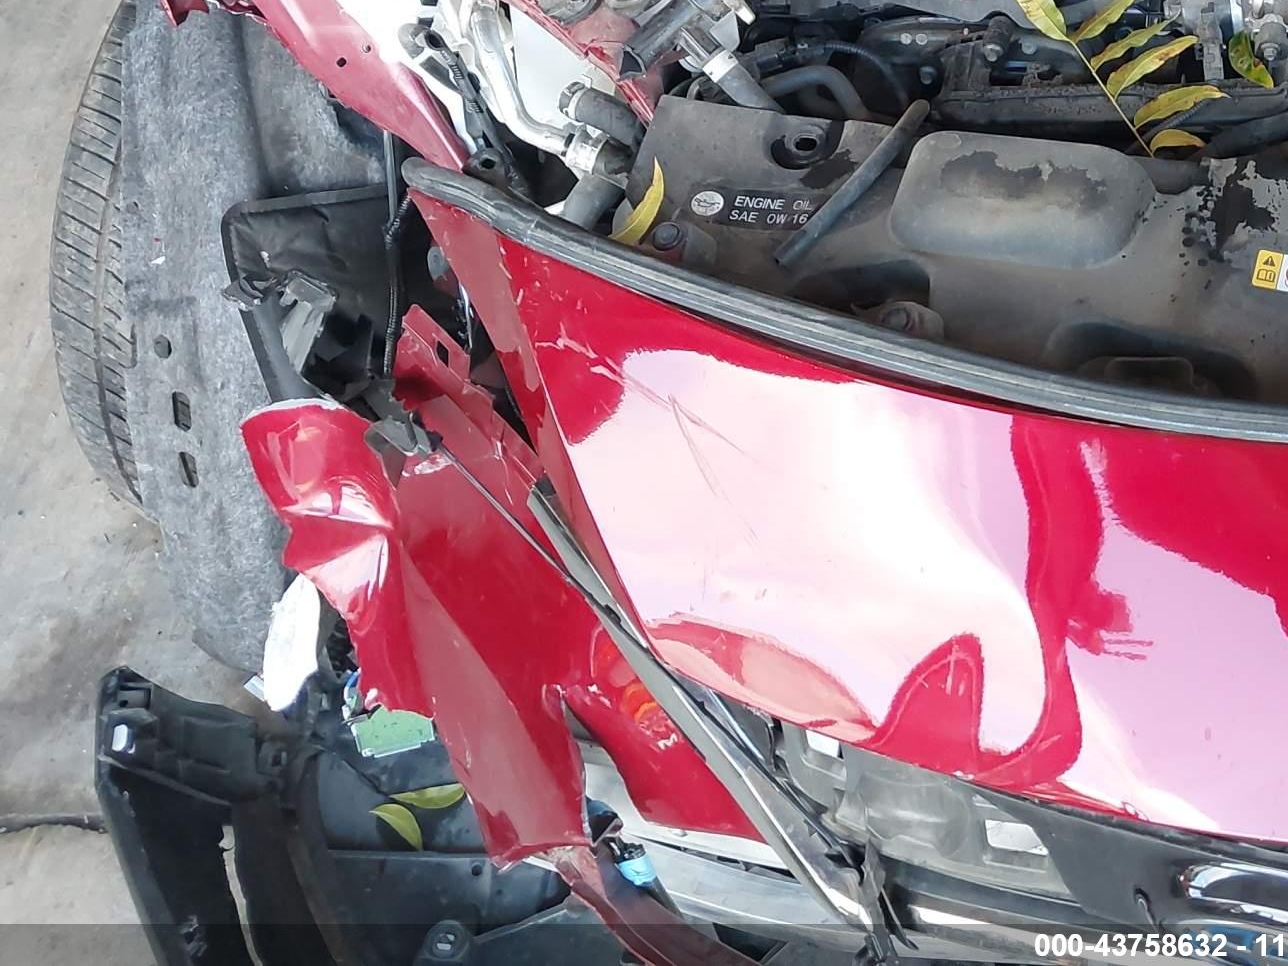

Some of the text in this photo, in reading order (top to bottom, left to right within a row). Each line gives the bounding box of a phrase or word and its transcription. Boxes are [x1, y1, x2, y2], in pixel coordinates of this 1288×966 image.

[734, 195, 814, 211] ENGINE OIL
[729, 209, 760, 223] SAE
